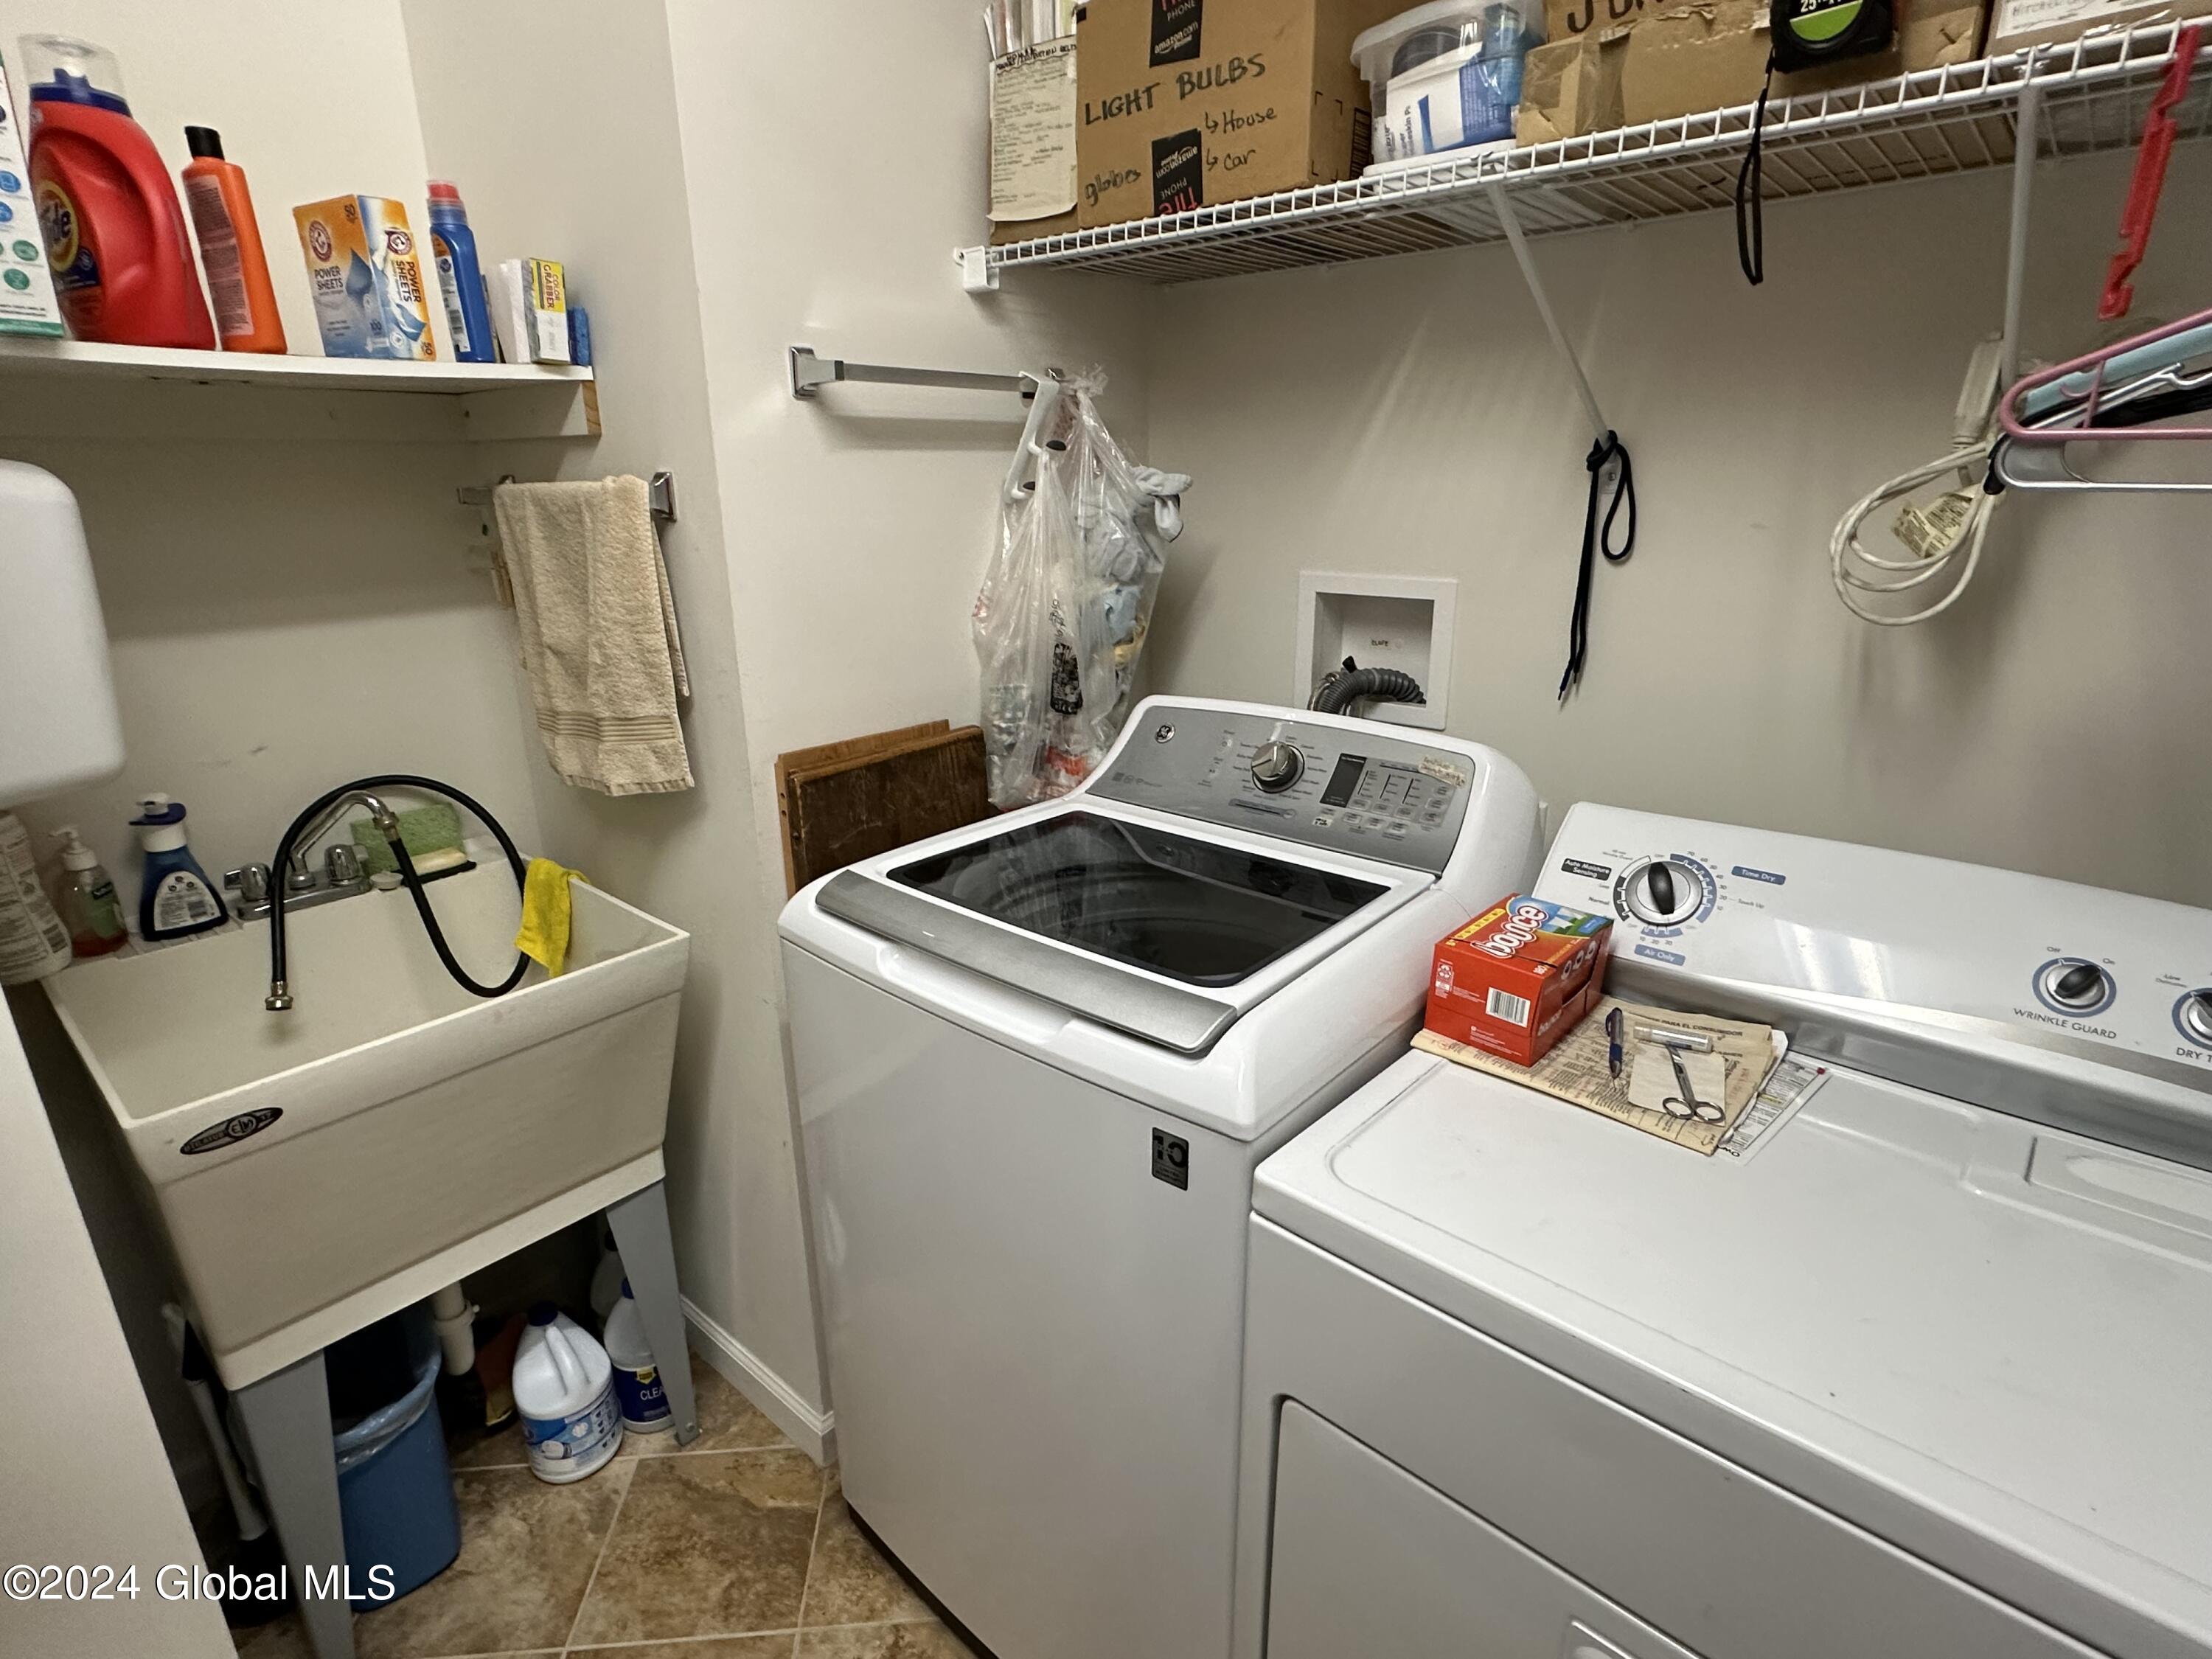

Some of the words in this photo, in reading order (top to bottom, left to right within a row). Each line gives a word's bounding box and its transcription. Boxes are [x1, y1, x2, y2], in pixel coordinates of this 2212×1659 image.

[1085, 83, 1161, 125] LIGHT
[1176, 53, 1265, 100] BULBS
[1223, 108, 1277, 133] House
[1085, 170, 1141, 206] globes
[314, 265, 341, 279] POWER
[396, 260, 413, 302] SHEETS
[406, 261, 421, 303] POWER
[316, 278, 344, 291] SHEETS
[543, 264, 554, 308] GRABBER
[1565, 859, 1581, 867] Auto
[1582, 863, 1610, 874] Moisture
[1573, 867, 1598, 878] Sensing
[1742, 869, 1759, 877] Time
[1761, 873, 1776, 882] Dry
[1588, 897, 1610, 905] Normal
[1472, 905, 1547, 958] bounce
[1658, 951, 1675, 961] Only
[2014, 1008, 2069, 1028] WRINKLE
[2071, 1022, 2117, 1039] GUARD
[2176, 1047, 2202, 1060] DRY
